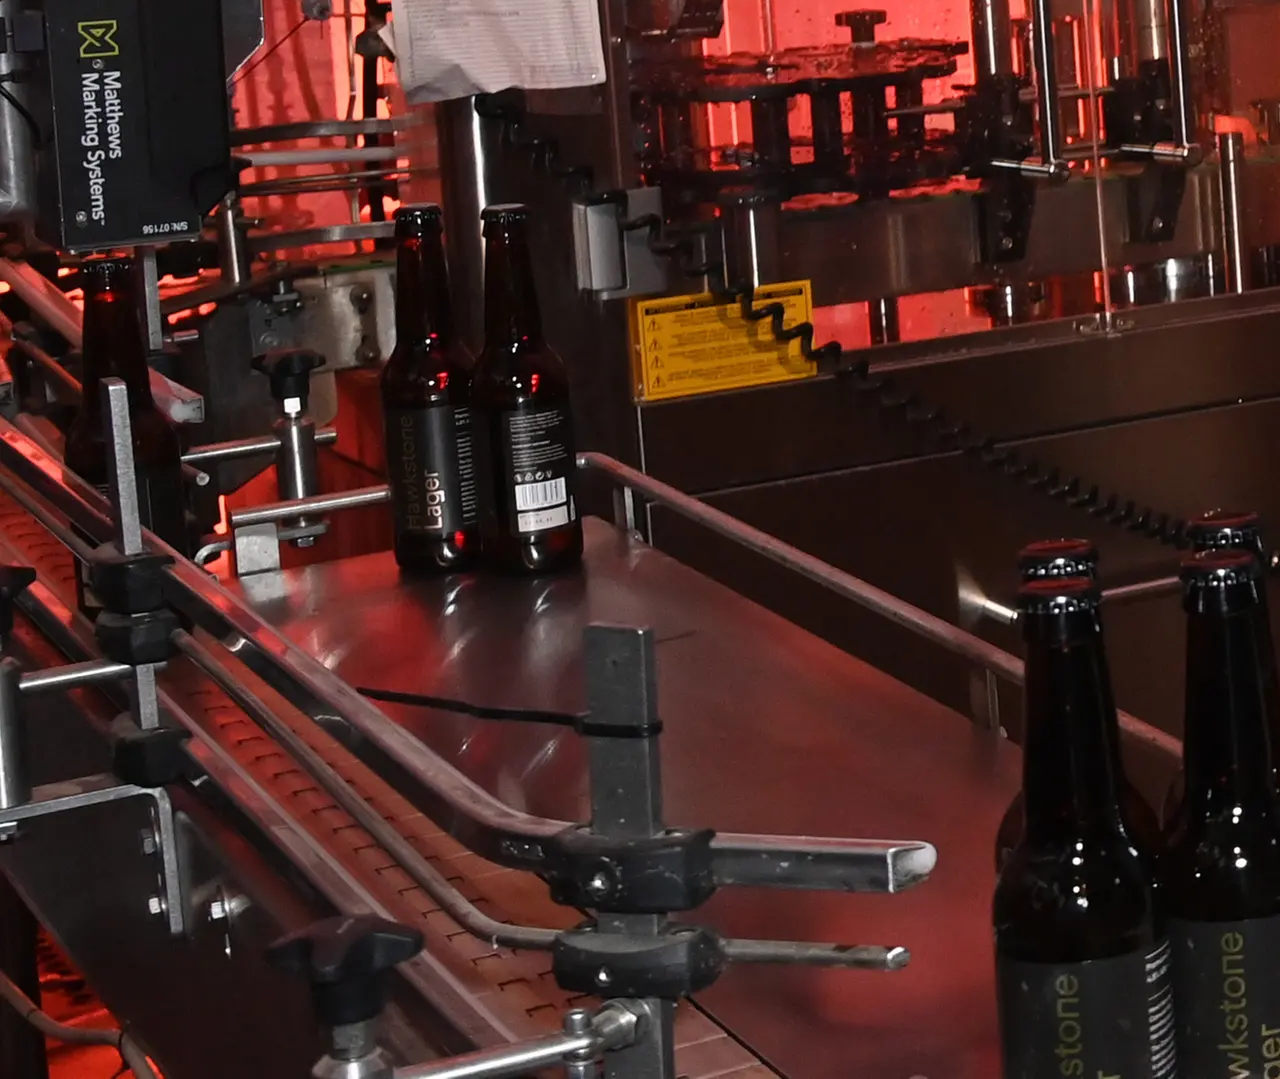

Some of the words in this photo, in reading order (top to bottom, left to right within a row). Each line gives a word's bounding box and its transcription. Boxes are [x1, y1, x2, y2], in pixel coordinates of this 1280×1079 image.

[81, 72, 101, 149] Marking
[102, 70, 124, 159] Matthews
[87, 150, 106, 222] Systems
[399, 415, 421, 531] Hawkstone
[423, 469, 446, 531] Lager
